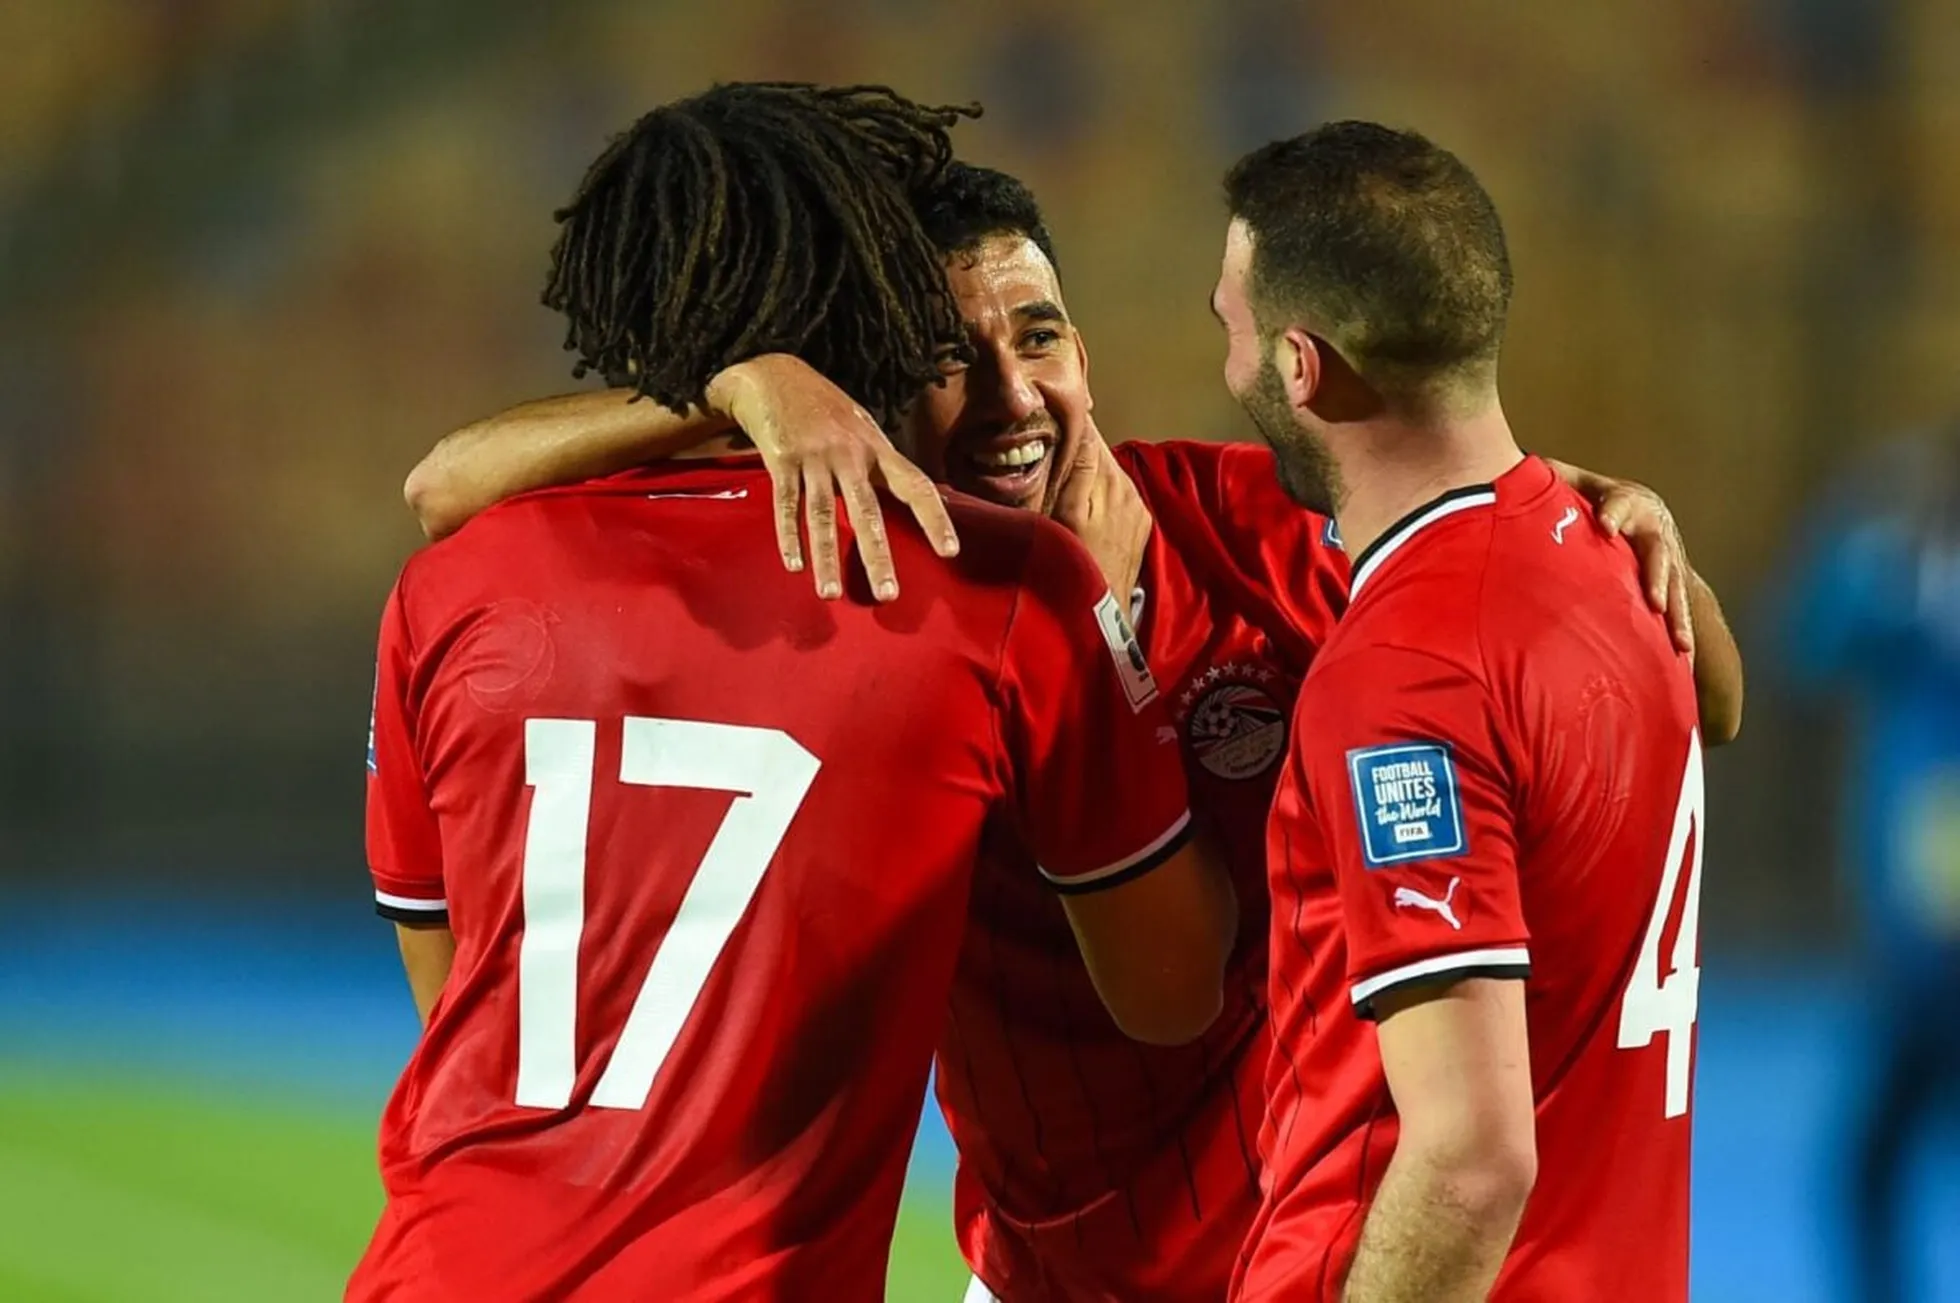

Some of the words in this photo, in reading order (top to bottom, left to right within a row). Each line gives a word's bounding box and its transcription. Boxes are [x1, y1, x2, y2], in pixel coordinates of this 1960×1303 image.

[1371, 761, 1433, 784] FOOTBALL
[1375, 776, 1436, 805] UNITES
[1375, 806, 1398, 825] the
[1399, 797, 1441, 820] World
[1400, 826, 1424, 837] FIFA
[515, 715, 822, 1111] 17
[1617, 725, 1704, 1119] 4
